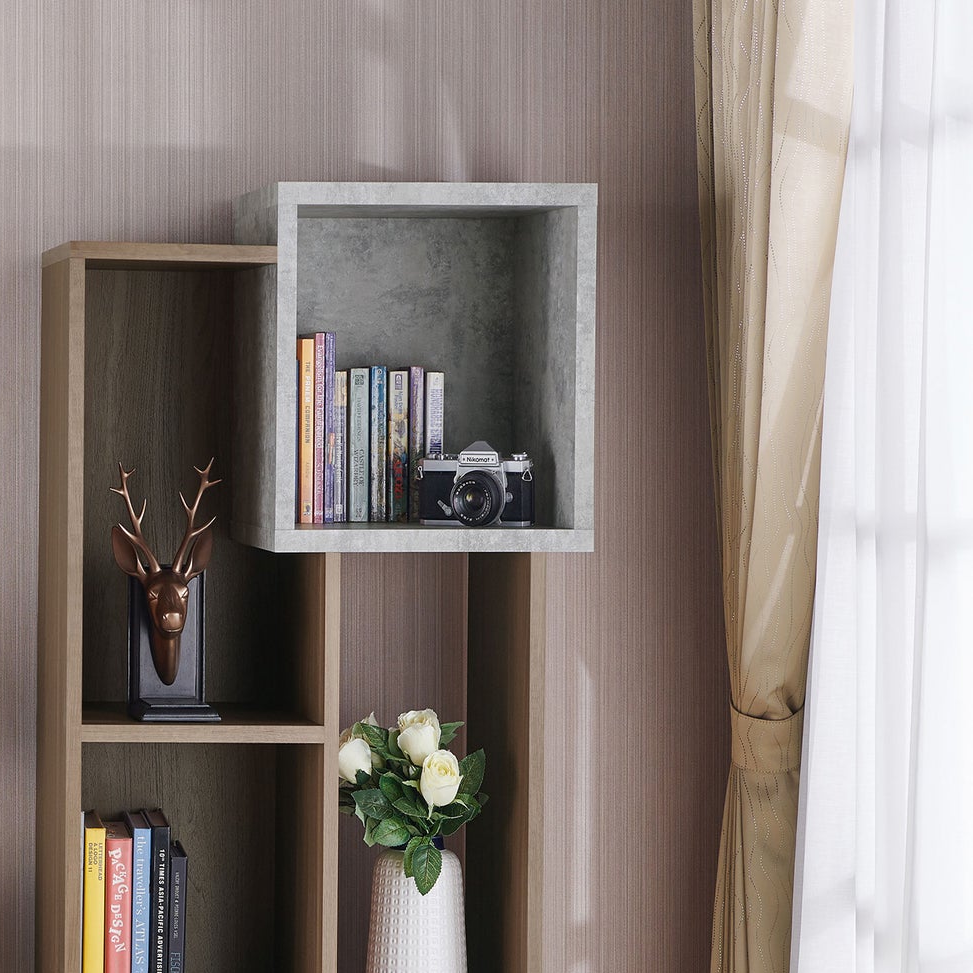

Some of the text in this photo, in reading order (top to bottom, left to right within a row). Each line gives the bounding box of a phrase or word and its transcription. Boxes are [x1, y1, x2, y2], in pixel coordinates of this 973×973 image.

[359, 476, 365, 487] OF
[108, 847, 129, 953] PACKAGE DESIGN
[135, 836, 147, 965] the traveller's ATLAS
